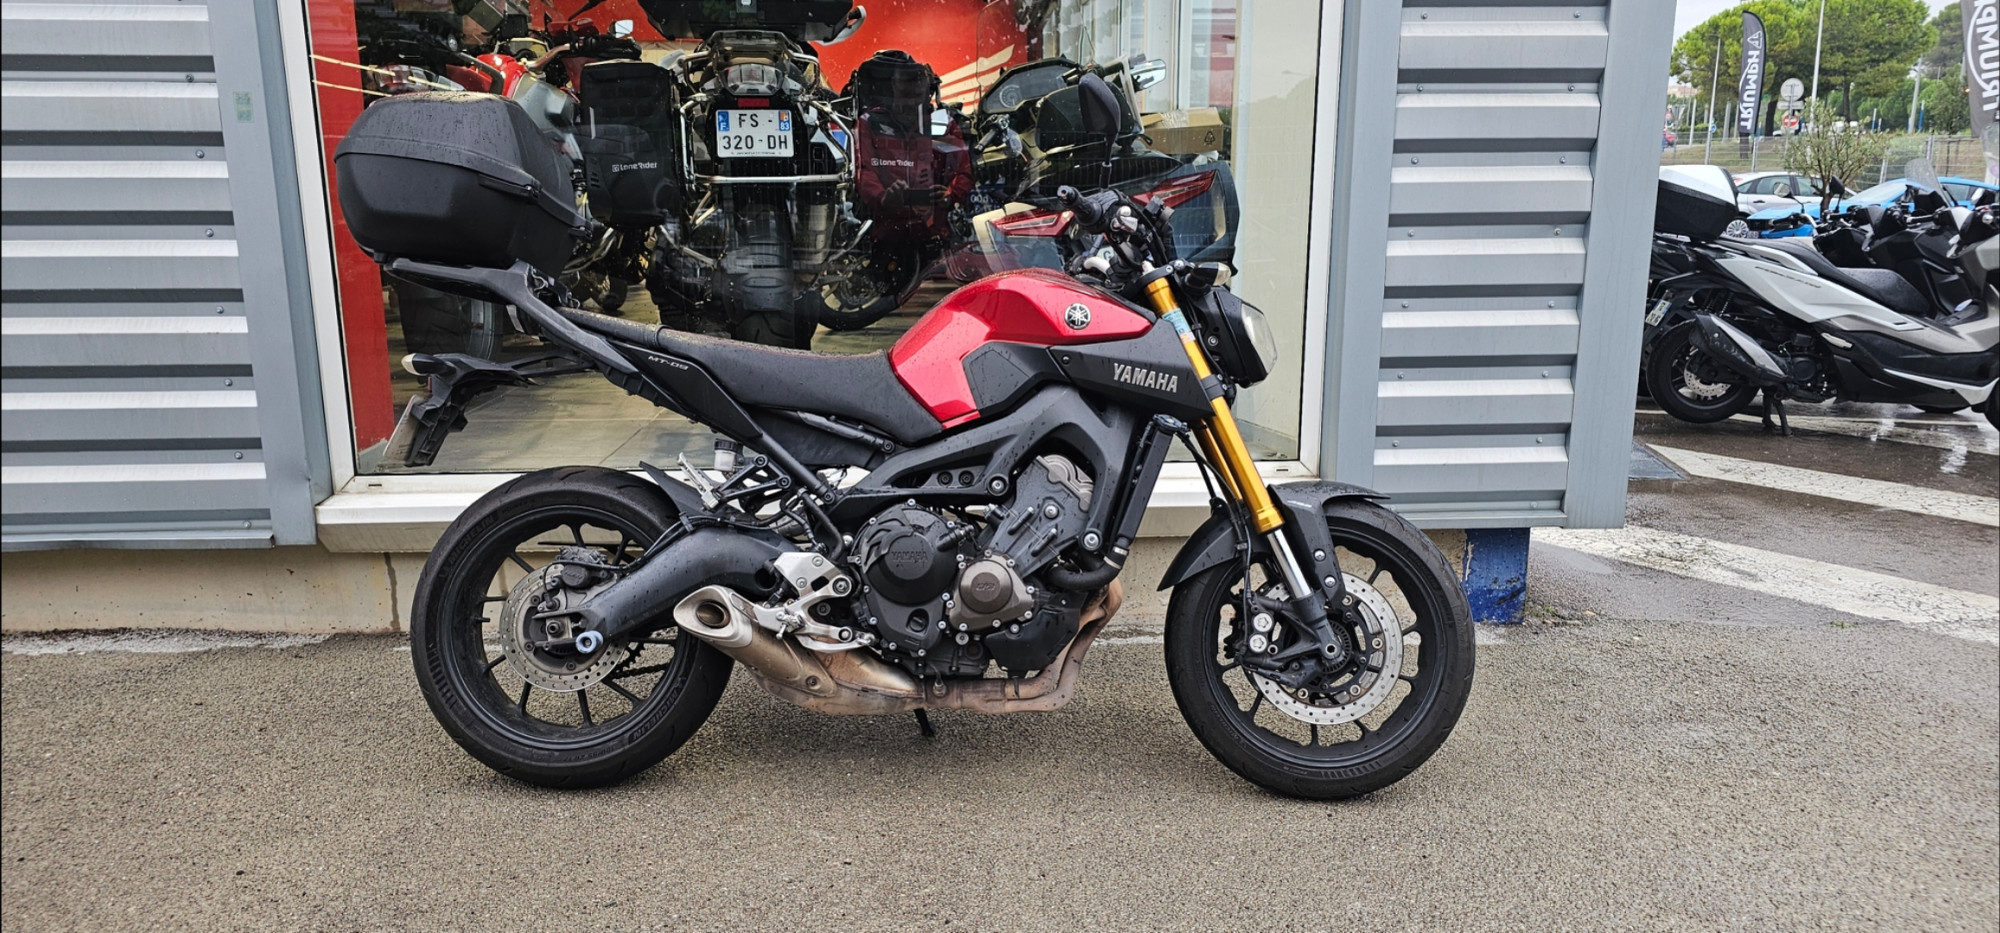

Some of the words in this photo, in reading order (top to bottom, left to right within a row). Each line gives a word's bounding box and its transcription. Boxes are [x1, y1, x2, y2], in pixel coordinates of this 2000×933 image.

[738, 113, 759, 128] FS
[780, 122, 790, 131] 83
[1113, 362, 1178, 394] YAMAHA
[891, 551, 928, 561] YAMAHA
[632, 687, 681, 741] MICHELIN
